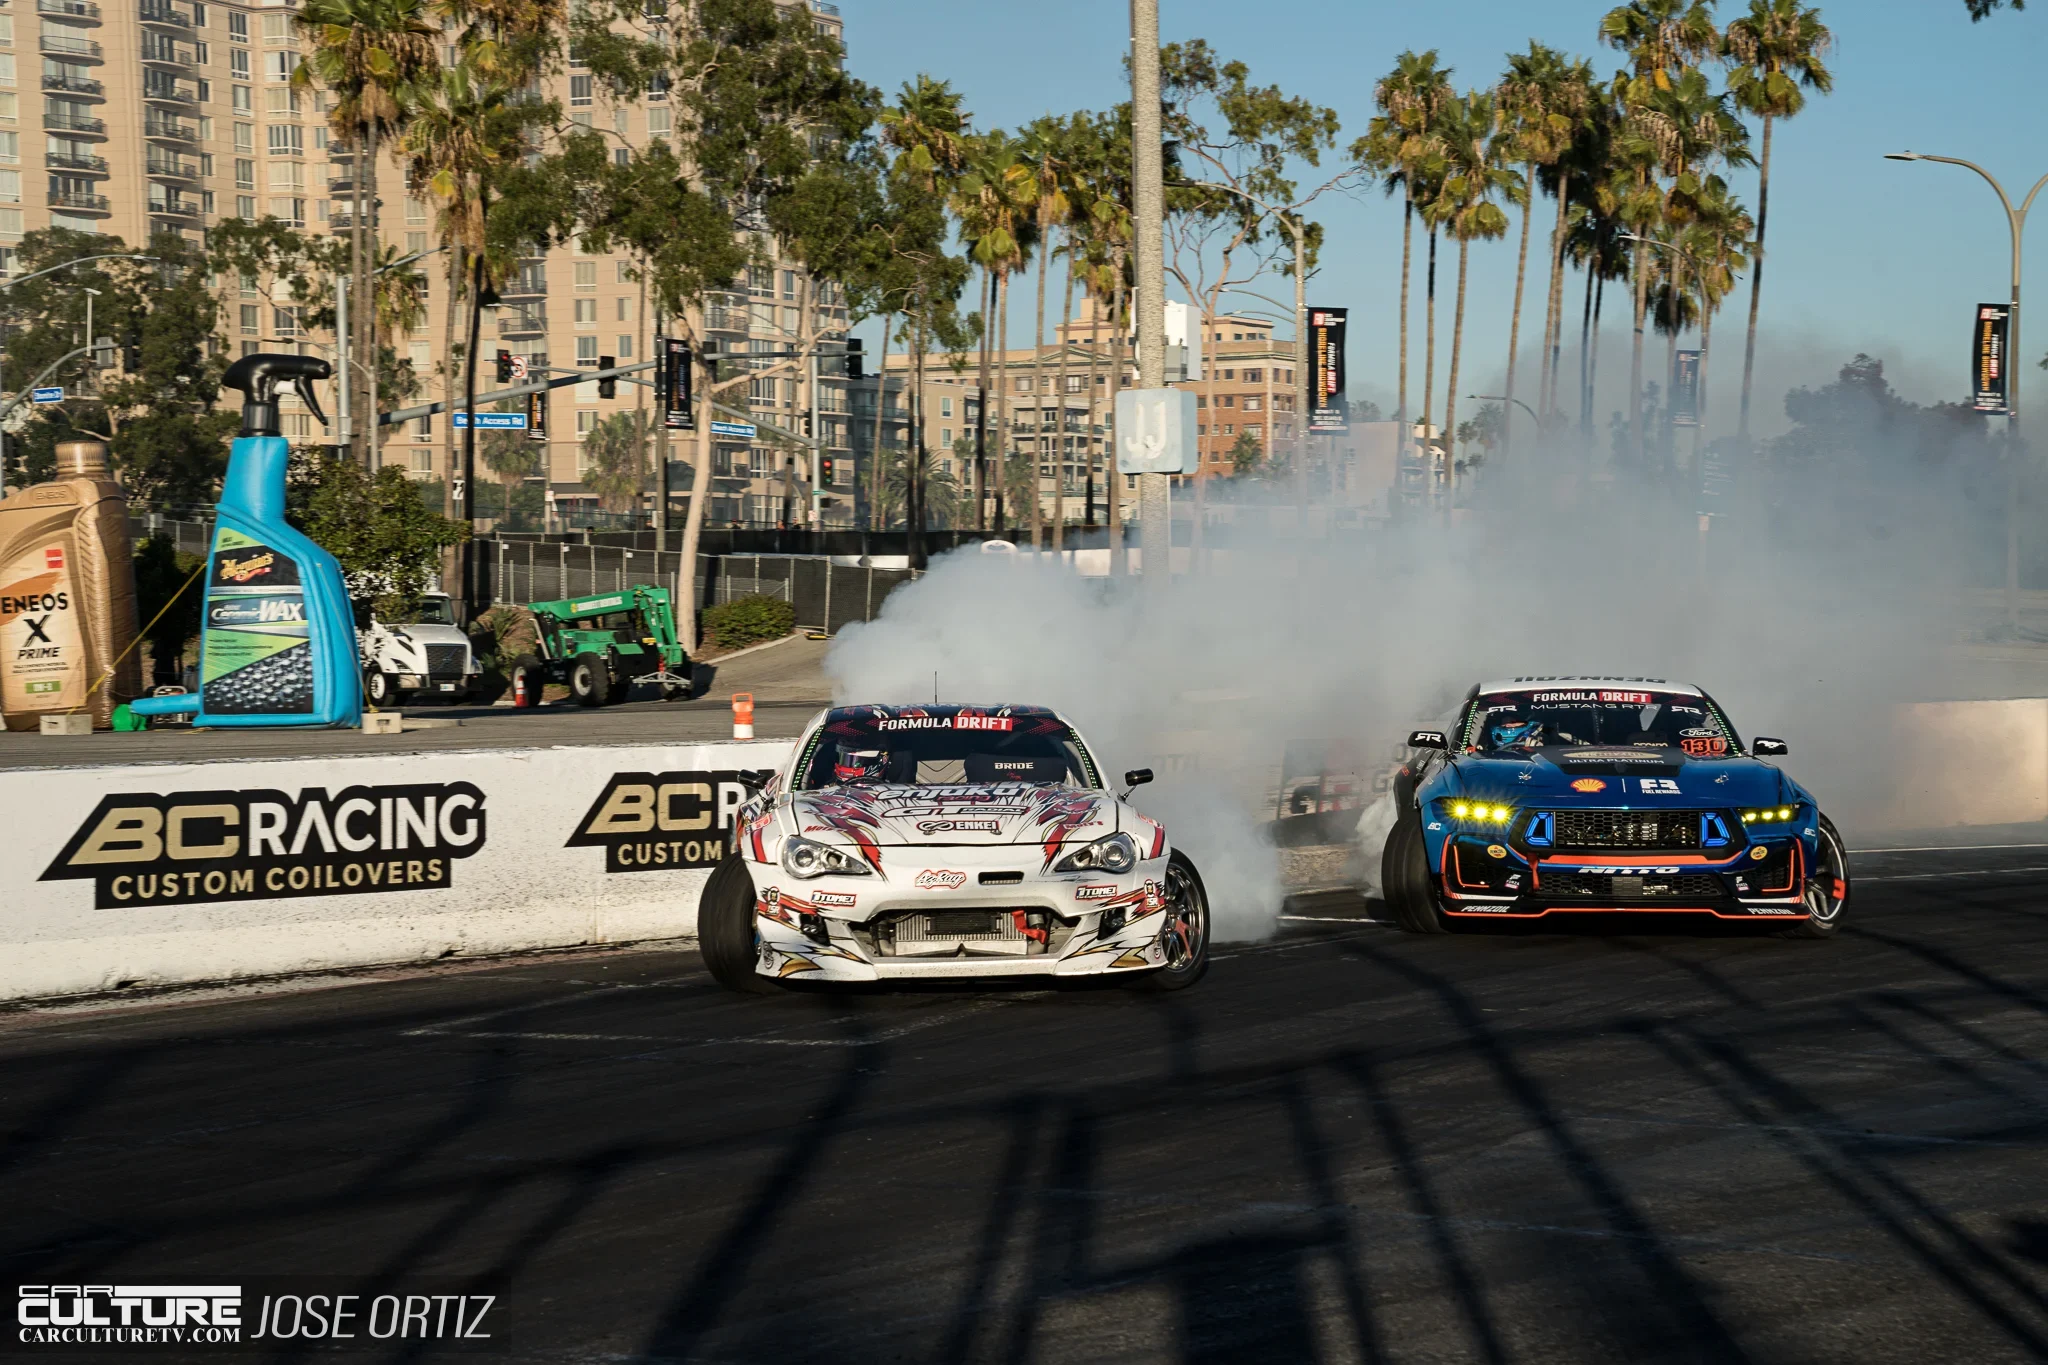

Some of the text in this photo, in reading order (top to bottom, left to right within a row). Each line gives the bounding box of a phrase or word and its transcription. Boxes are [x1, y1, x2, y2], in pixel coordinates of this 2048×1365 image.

[456, 416, 523, 425] Beh Access Rd
[1, 592, 68, 614] ENEOS
[259, 600, 304, 621] WAX
[22, 614, 51, 647] X
[17, 647, 60, 660] PRIME
[1533, 691, 1649, 702] FORMULA DRIFT
[878, 716, 1011, 731] FORMULA DRIFT
[1415, 732, 1442, 742] RTR
[1681, 738, 1727, 753] 130
[994, 761, 1034, 770] BRIDE
[877, 786, 1025, 801] enjuku
[586, 783, 712, 836] BC
[881, 806, 961, 817] GT
[67, 794, 481, 866] BC RACING
[955, 821, 997, 830] ENKEI
[1427, 822, 1441, 831] BC
[1804, 827, 1816, 837] BC
[617, 839, 723, 867] CUSTOM
[1578, 866, 1680, 874] NITTO
[111, 858, 444, 902] CUSTOM COILOVERS
[1084, 886, 1117, 896] TOMEI
[820, 894, 855, 904] TOMEI
[1461, 905, 1511, 913] PENNZOIL
[1747, 907, 1796, 915] PENNZOIL
